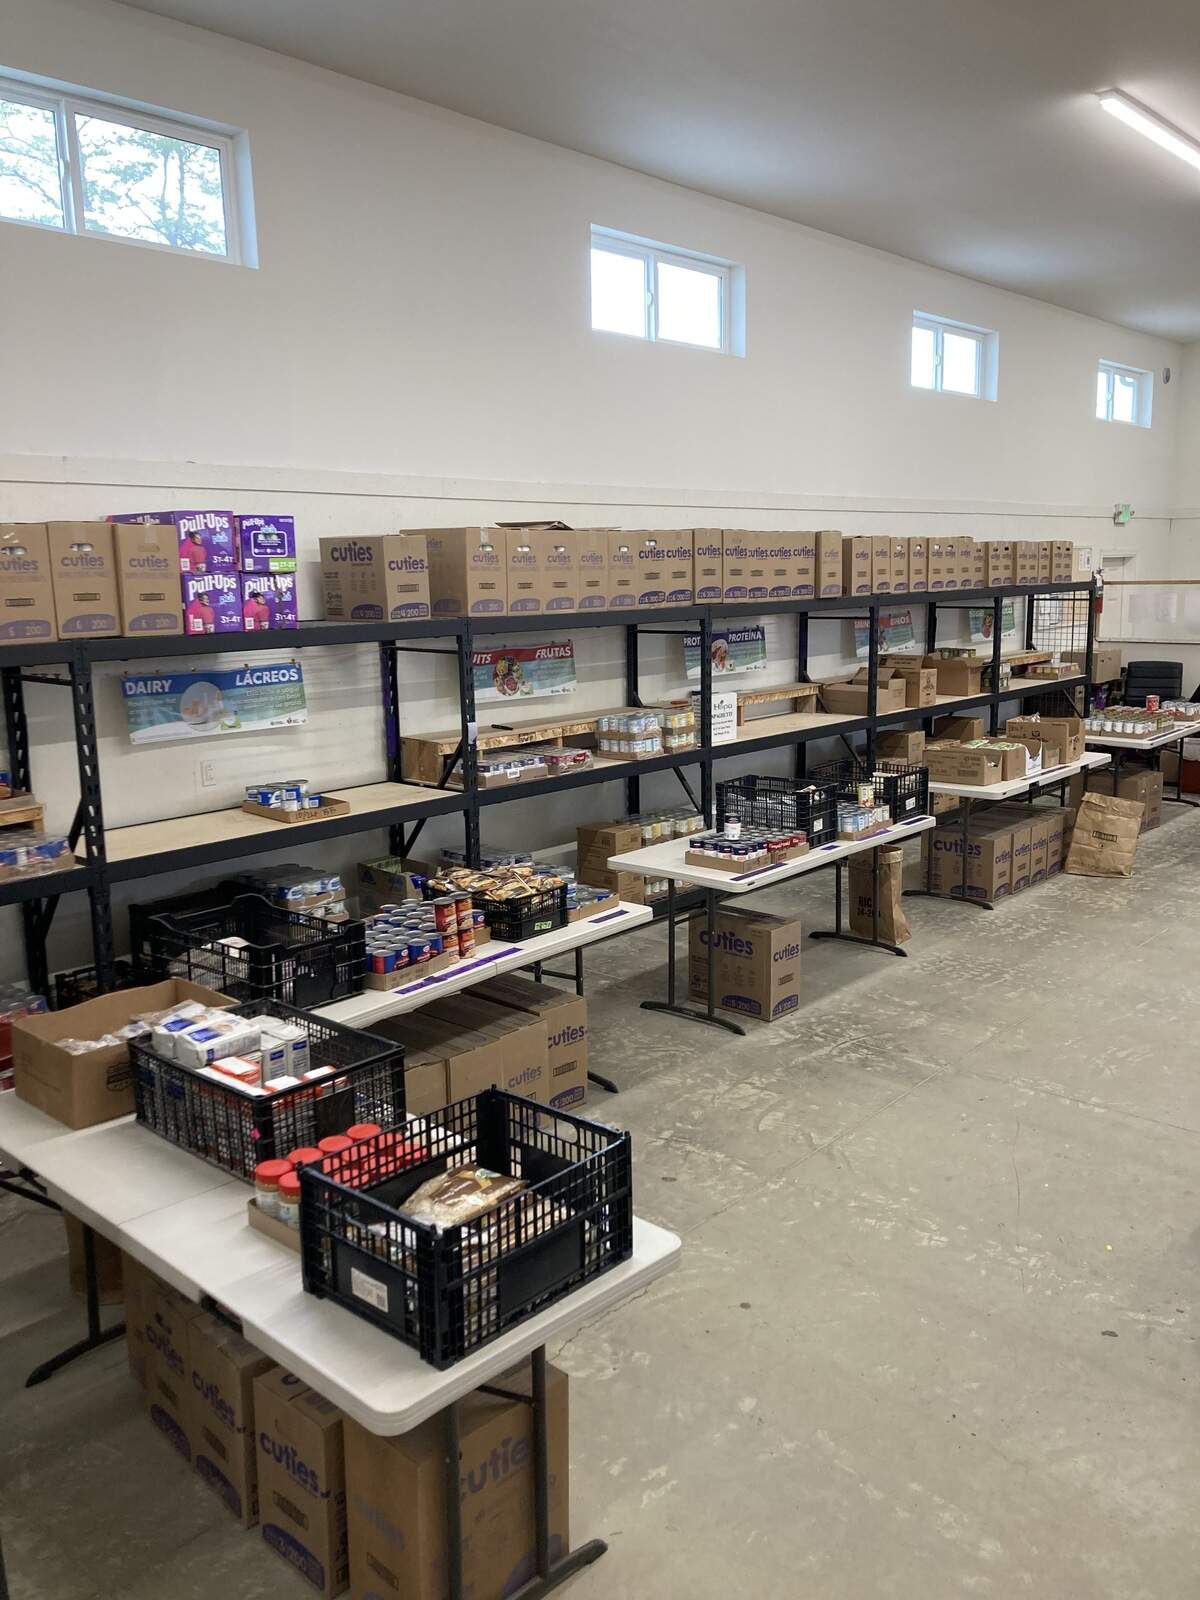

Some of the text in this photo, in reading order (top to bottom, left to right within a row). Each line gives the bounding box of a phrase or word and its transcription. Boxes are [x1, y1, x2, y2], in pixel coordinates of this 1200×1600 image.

[179, 513, 229, 540] Pull-Ups
[331, 541, 374, 562] cuties
[638, 547, 665, 560] cuties
[666, 546, 692, 559] cuties
[697, 545, 721, 556] cuties
[725, 545, 747, 557] cuties
[770, 547, 791, 558] cuties
[793, 546, 814, 557] cuties
[61, 553, 105, 568] cuties
[128, 555, 169, 568] cuties
[212, 555, 233, 564] 3T-4T
[388, 555, 426, 571] cuties
[472, 552, 499, 564] cuties
[511, 553, 537, 564] cuties
[188, 574, 237, 601] Pull-Ups
[220, 615, 242, 624] 3T-4T
[728, 630, 763, 643] PROTEÍNA
[535, 646, 572, 659] FRUTAS
[235, 667, 299, 687] LÁCREOS
[125, 679, 172, 696] DAIRY
[773, 943, 799, 963] cuties
[508, 1064, 542, 1089] cuties
[192, 1369, 236, 1431] cuties
[259, 1431, 319, 1495] cuties
